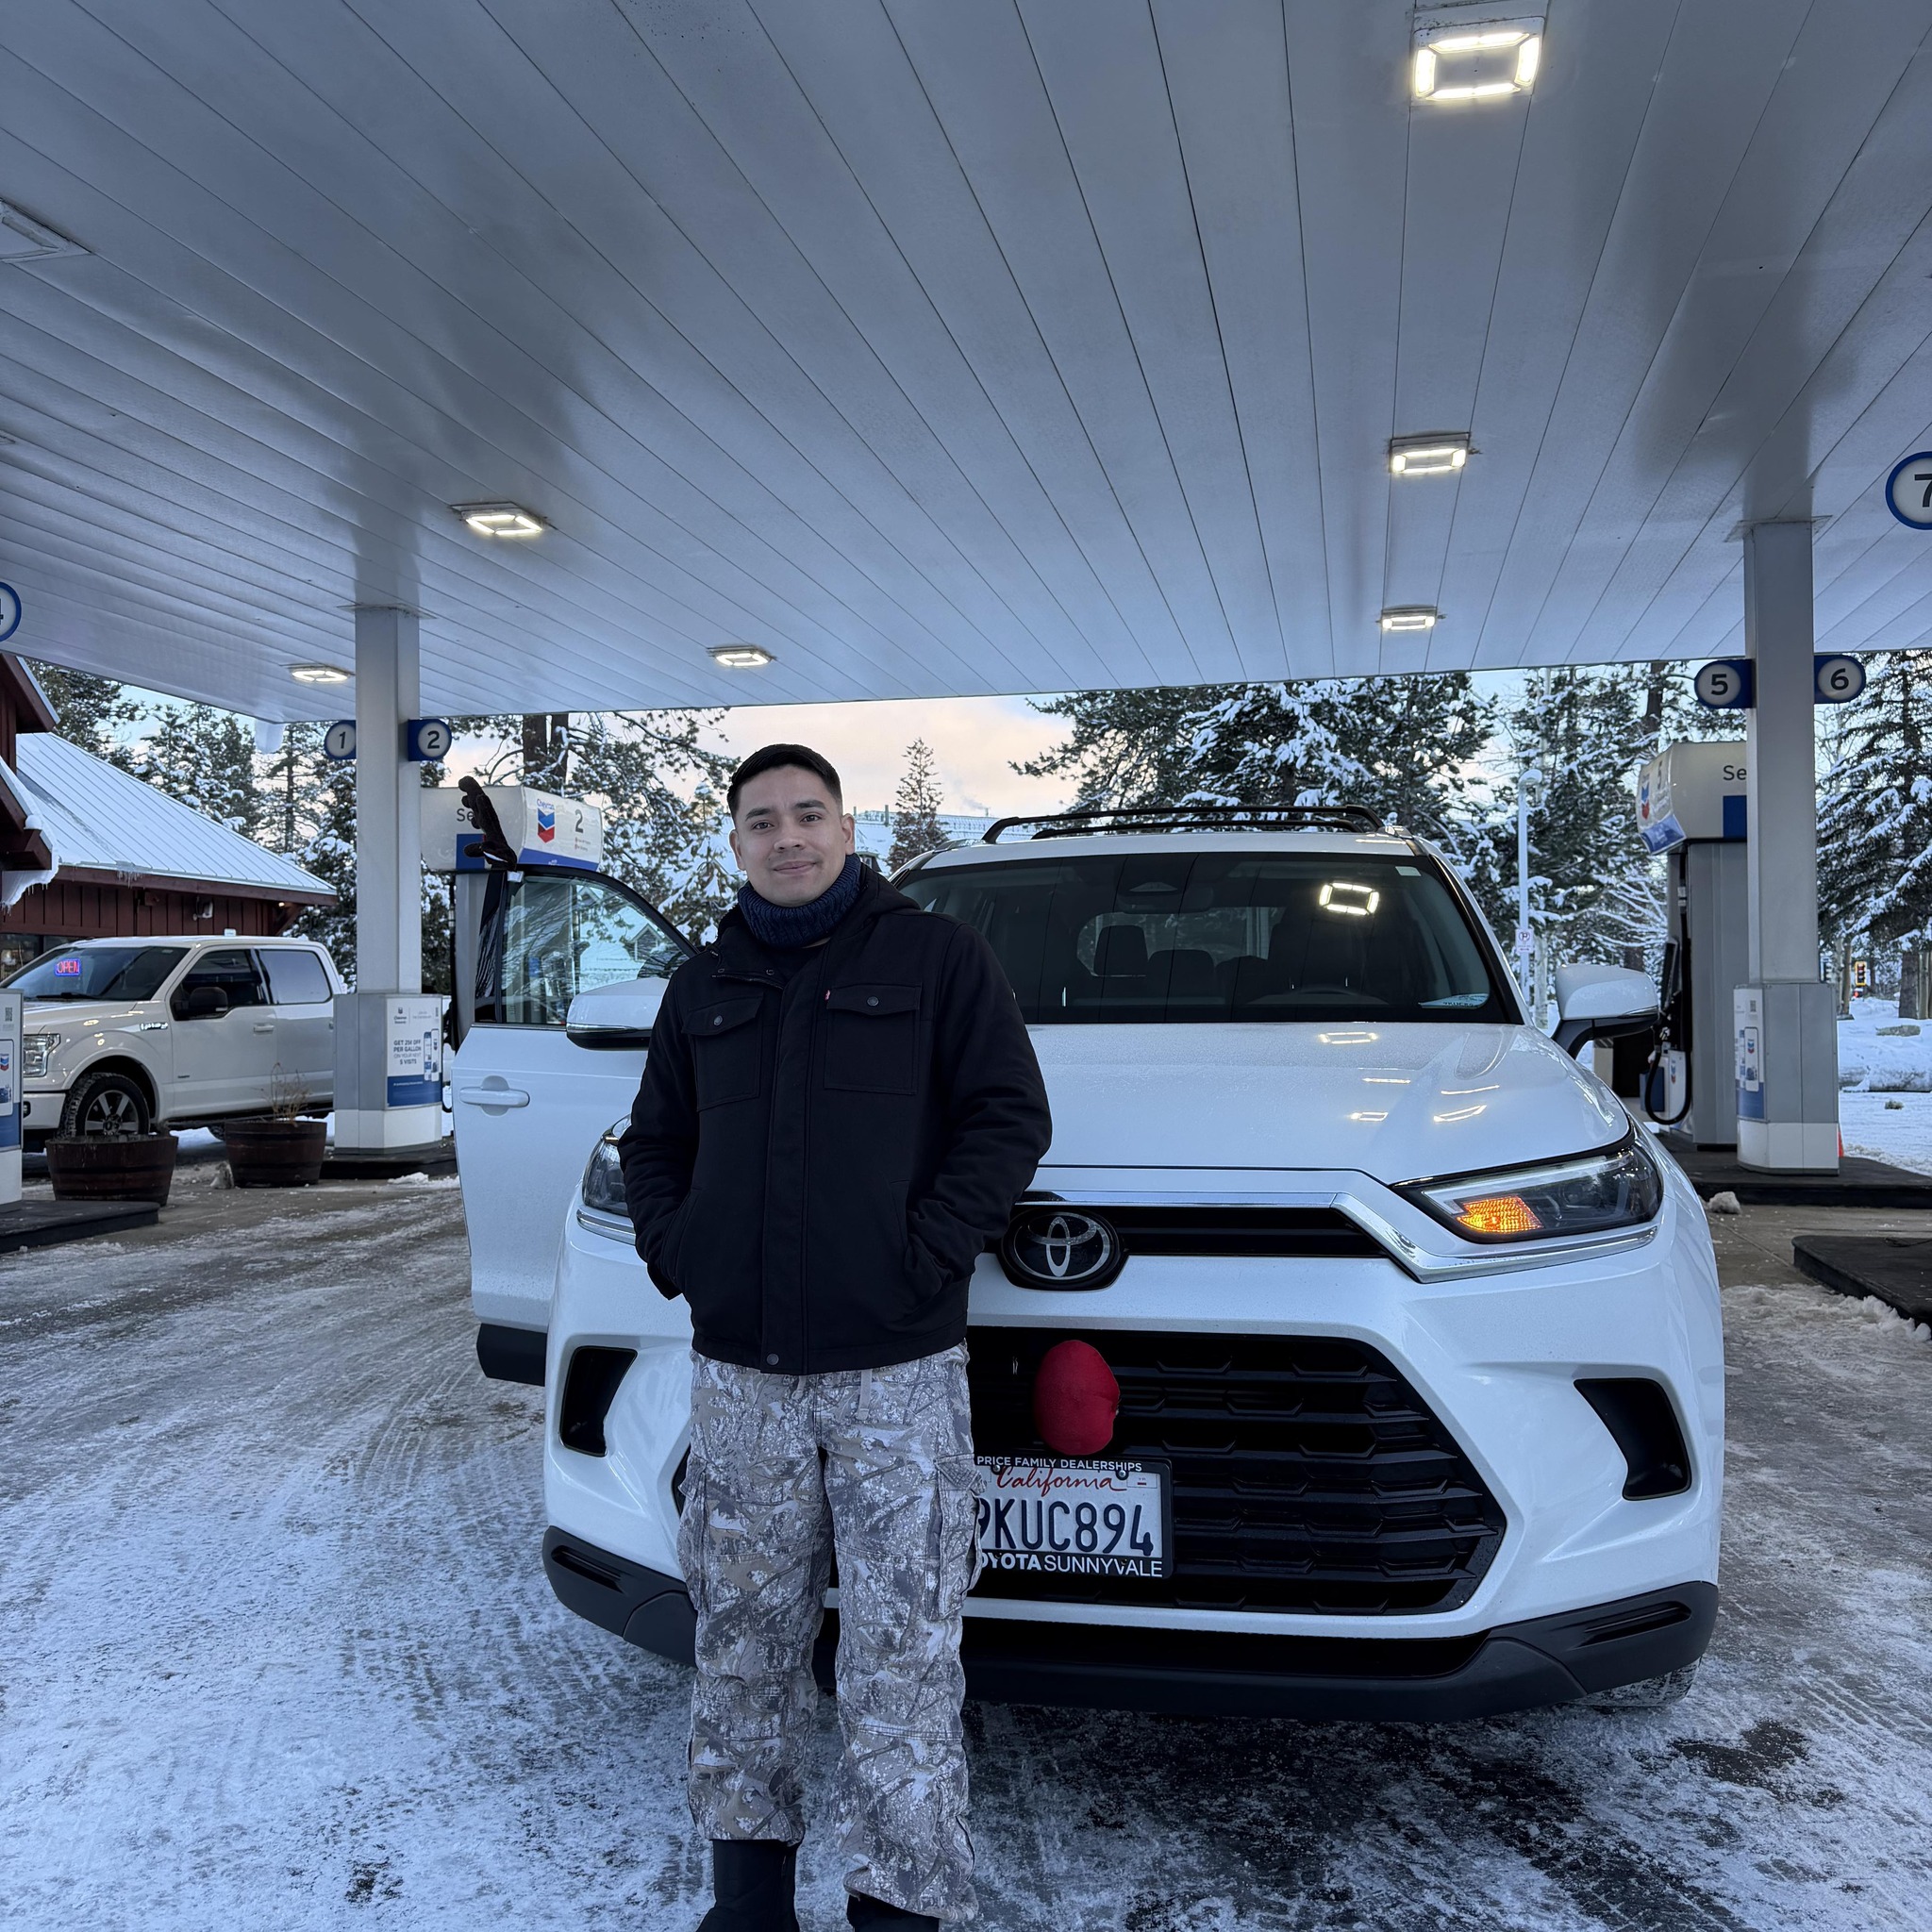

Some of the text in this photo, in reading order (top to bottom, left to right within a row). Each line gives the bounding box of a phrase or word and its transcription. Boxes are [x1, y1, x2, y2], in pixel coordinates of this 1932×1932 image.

[1914, 474, 1932, 508] 7
[1710, 673, 1728, 696] 5
[1830, 667, 1849, 691] 6
[339, 731, 346, 749] 1
[427, 730, 440, 749] 2
[575, 808, 584, 834] 2
[58, 960, 78, 974] OPEN
[976, 1456, 1142, 1472] PRICE FAMILY DEALERSHIPS
[996, 1466, 1127, 1498] California
[1044, 1556, 1163, 1578] SUNNYVALE
